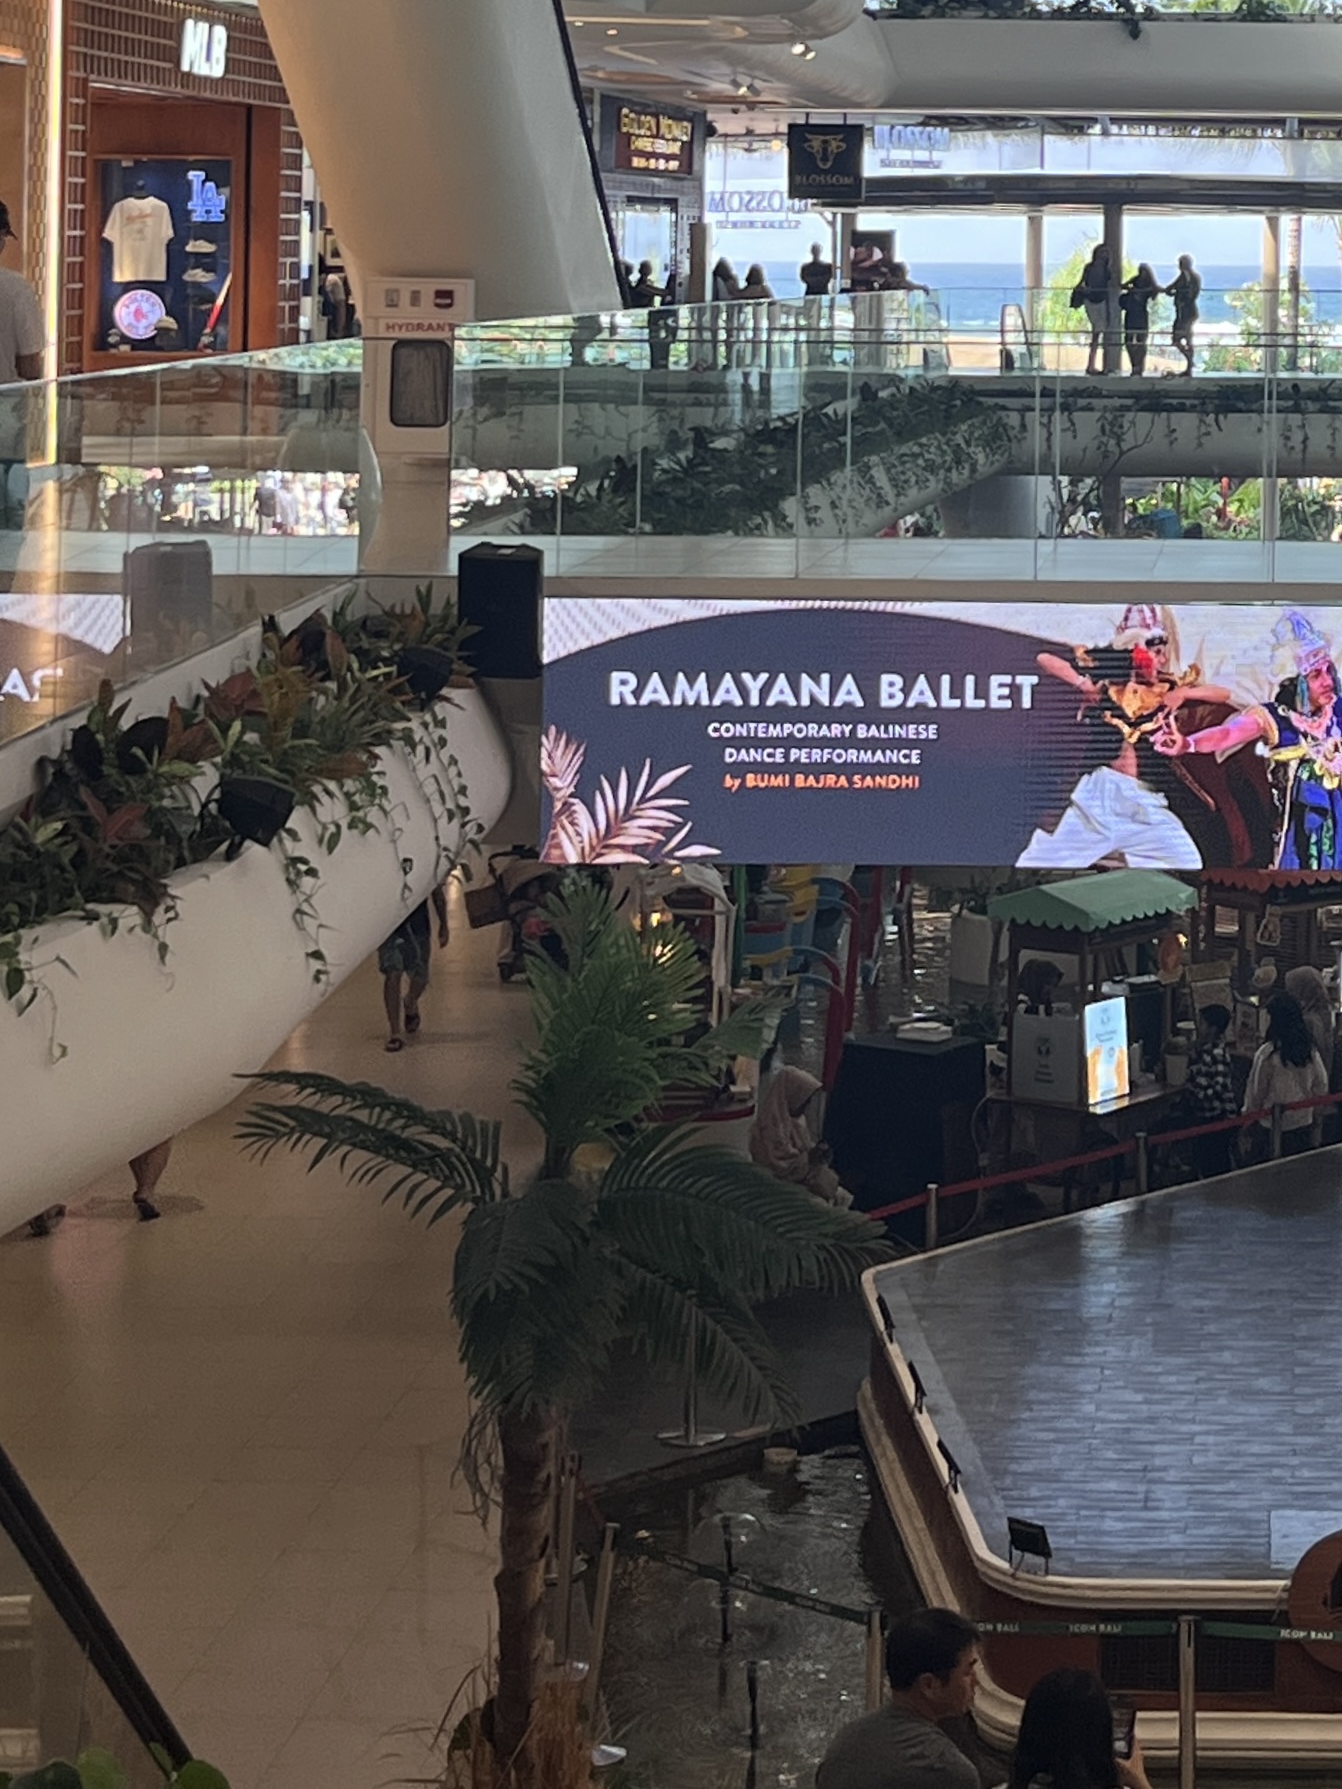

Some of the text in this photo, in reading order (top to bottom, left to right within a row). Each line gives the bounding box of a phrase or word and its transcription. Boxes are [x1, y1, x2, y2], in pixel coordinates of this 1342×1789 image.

[180, 18, 228, 78] MLB
[385, 322, 454, 333] HYDRANT
[609, 671, 1039, 709] RAMAYANA BALLET
[707, 722, 939, 740] CONTEMPORARY BALINESE
[724, 748, 921, 765] DANCE PERFORMANCE
[723, 773, 920, 792] by BUMI BAJRA SANDHI
